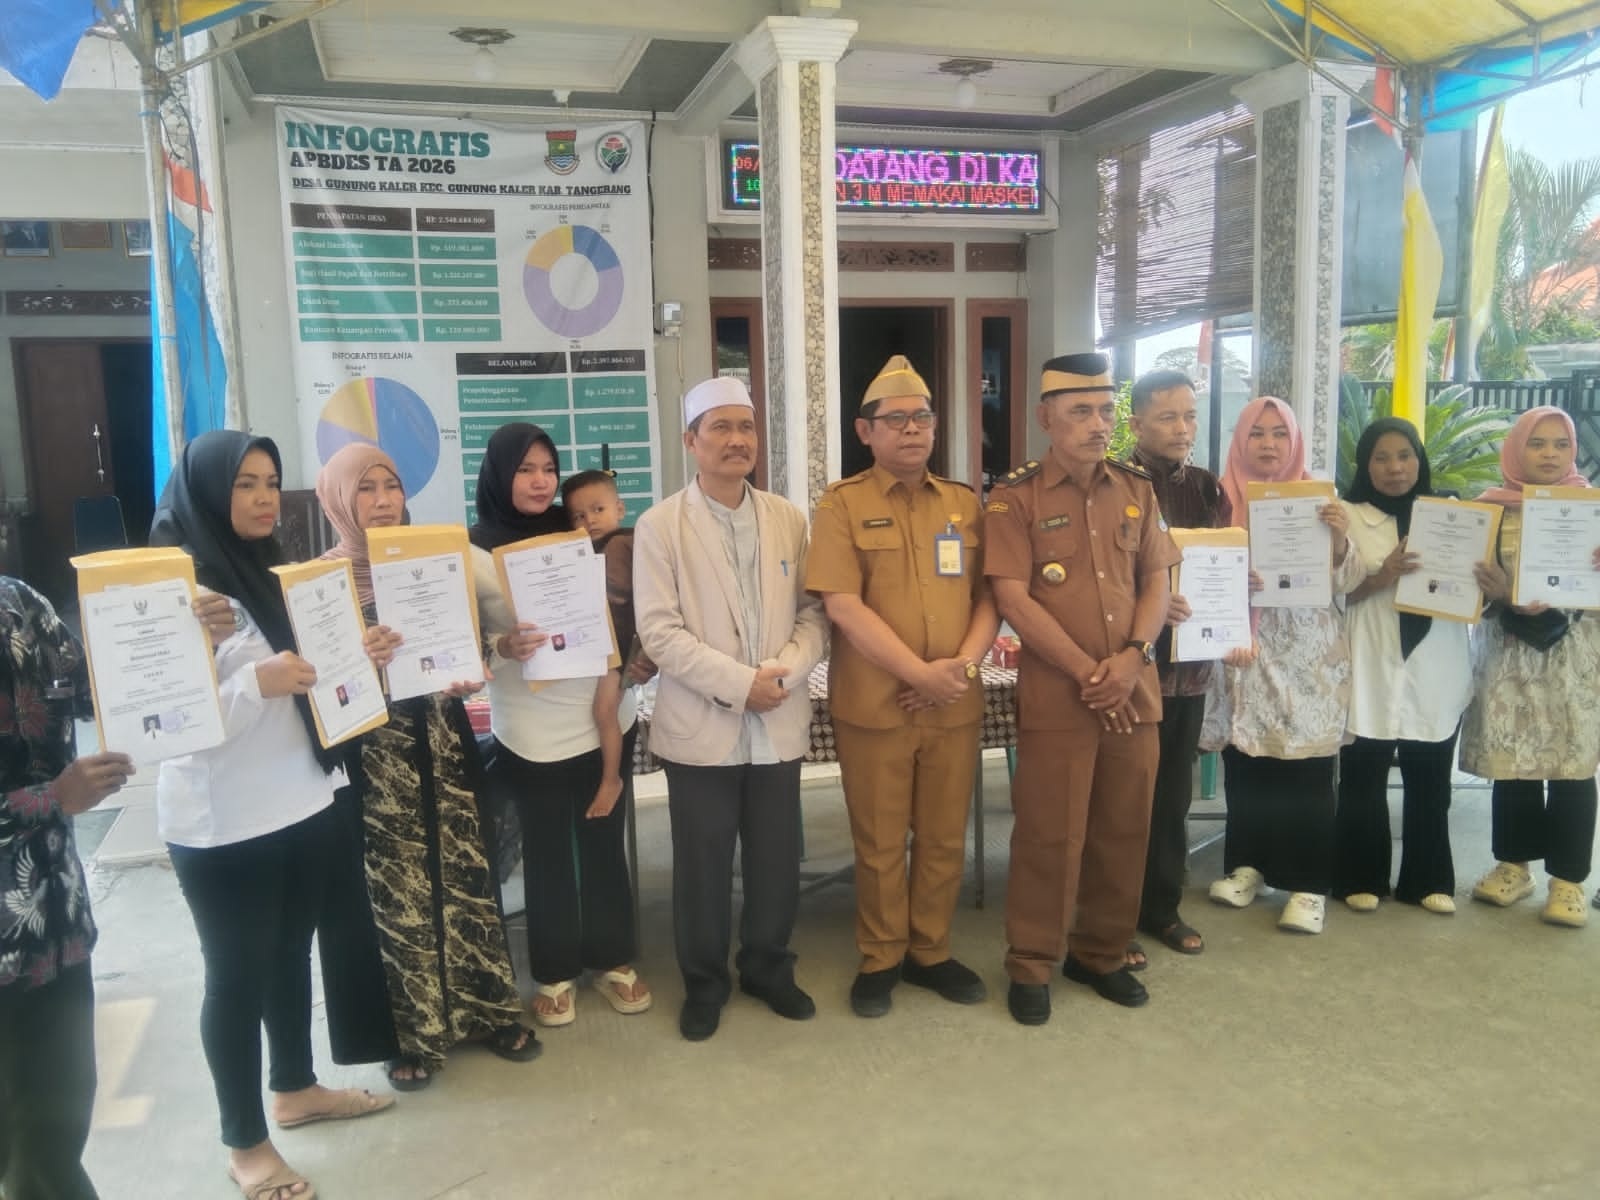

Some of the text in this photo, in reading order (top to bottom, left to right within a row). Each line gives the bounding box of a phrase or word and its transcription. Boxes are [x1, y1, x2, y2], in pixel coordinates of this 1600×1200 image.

[284, 121, 491, 158] INFOGRAFIS
[290, 151, 457, 175] APBDES TA 2026
[960, 155, 987, 182] DI
[292, 177, 322, 188] DESA
[325, 179, 376, 191] GUNUNG
[379, 181, 417, 192] KALER
[448, 183, 495, 194] GUNUNG
[499, 184, 536, 195] KALER
[566, 185, 631, 196] TANGERANG
[887, 184, 965, 202] MEMAKAI
[316, 211, 366, 222] PENAPATAN
[332, 352, 413, 360] INFOGRAFIS BELANJA
[488, 360, 518, 368] BELANJA
